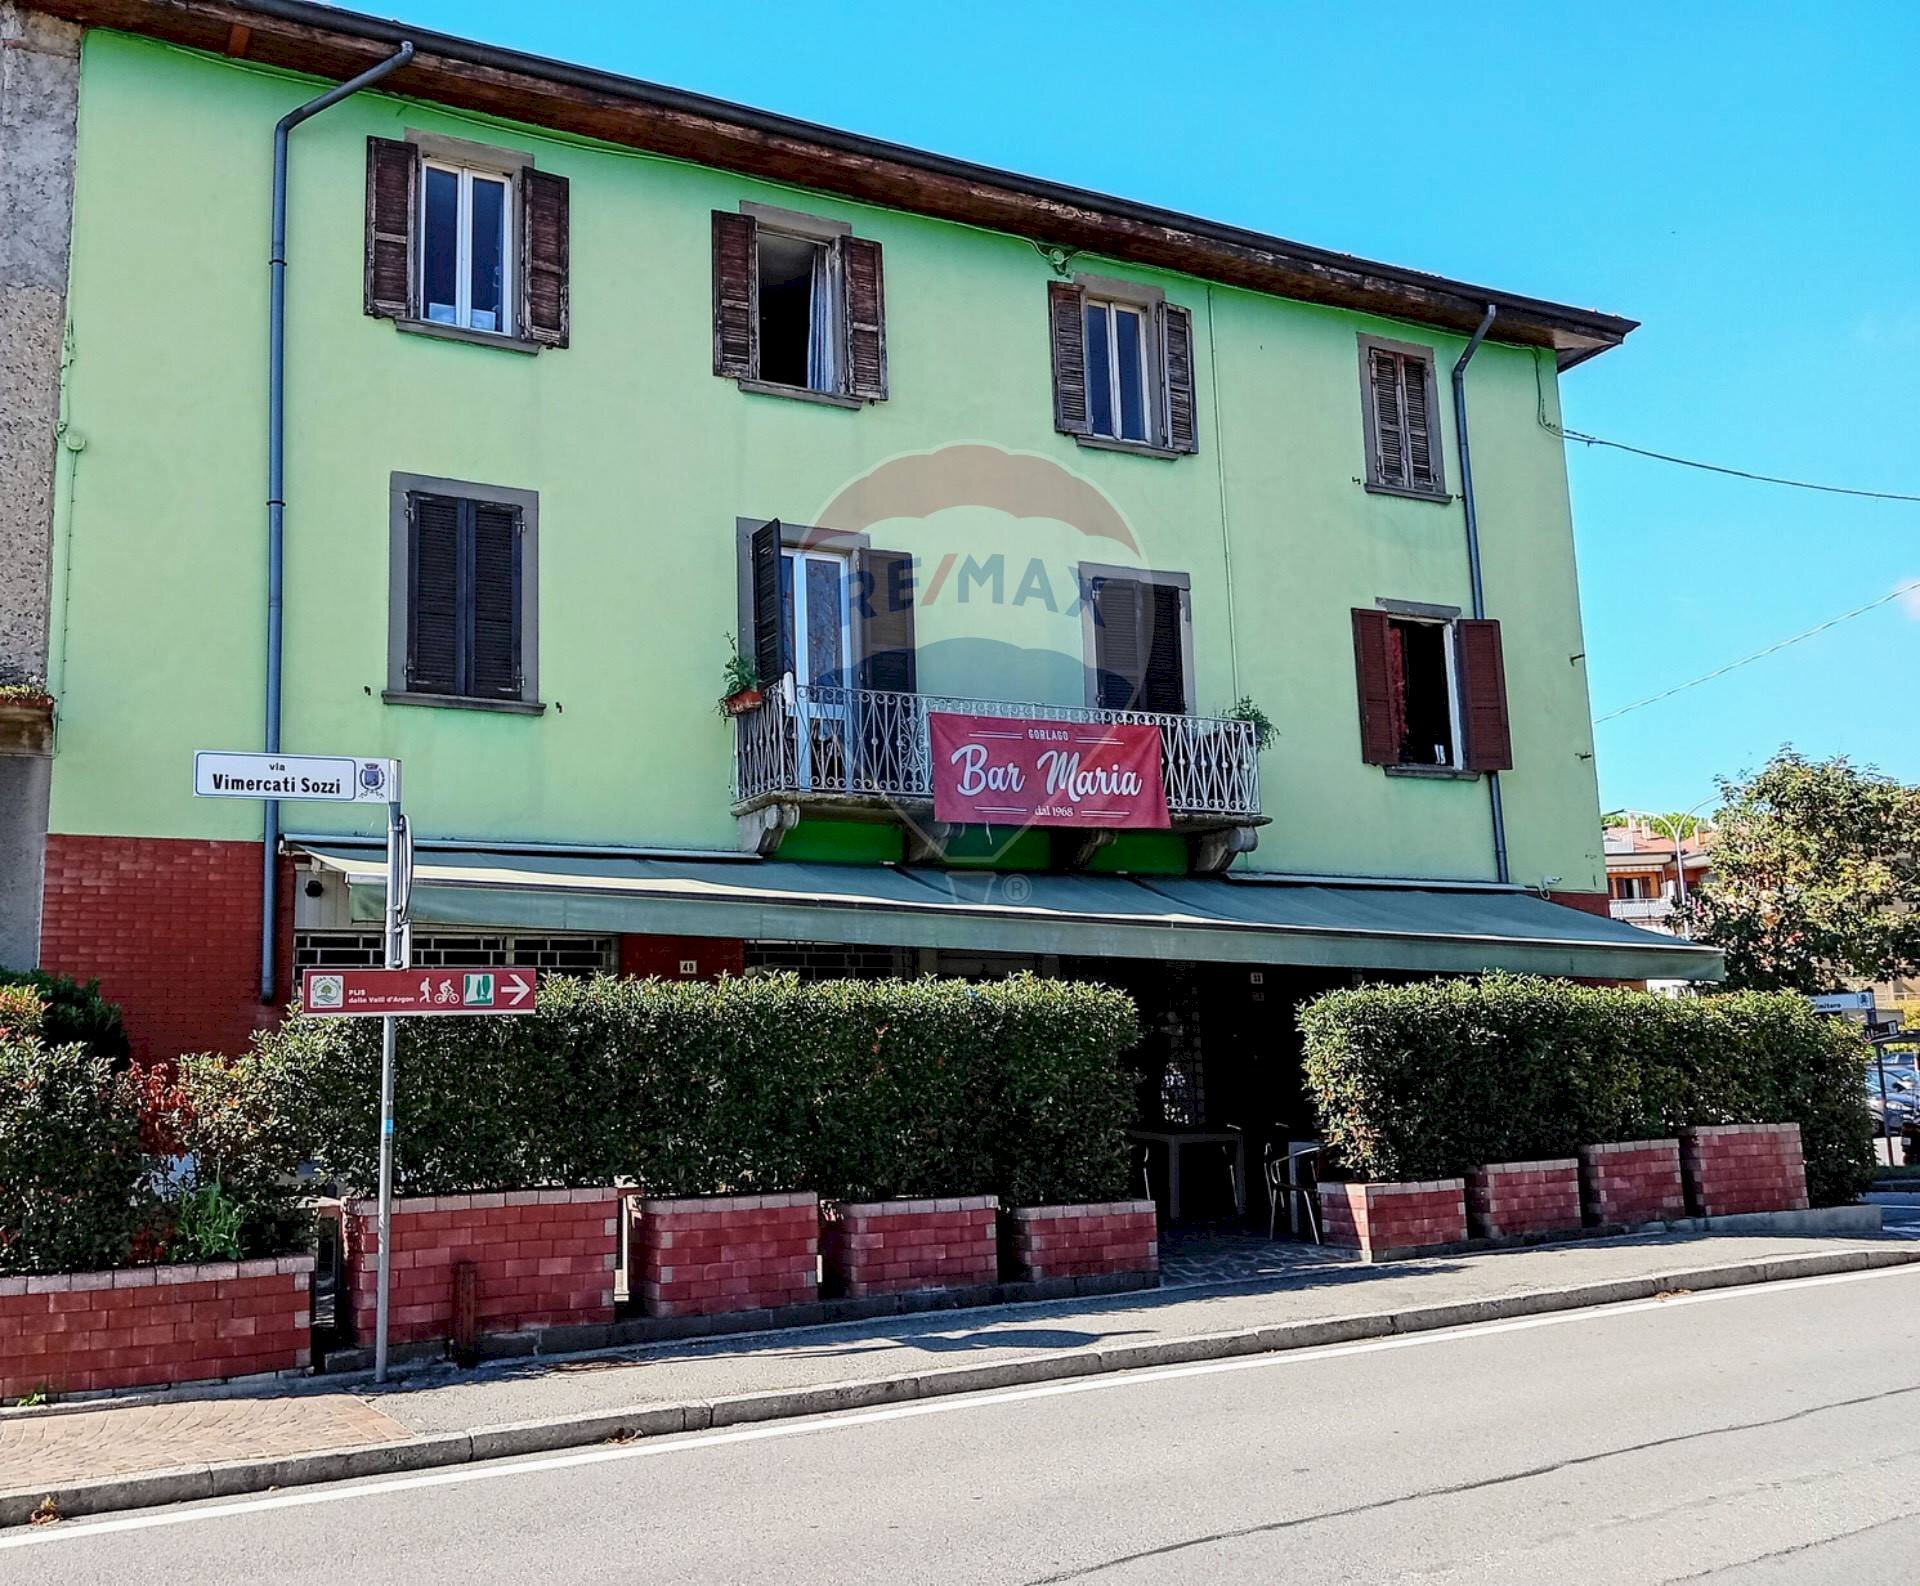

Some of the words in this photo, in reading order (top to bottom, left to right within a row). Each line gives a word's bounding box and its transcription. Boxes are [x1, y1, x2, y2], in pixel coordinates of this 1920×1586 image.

[1028, 728, 1069, 741] GORLAGO
[268, 762, 285, 771] via
[951, 743, 1026, 796] Bar
[1036, 750, 1142, 802] Maria
[212, 773, 296, 792] Vimercati
[301, 777, 340, 794] Sozzi
[1034, 806, 1051, 816] dal
[1052, 806, 1074, 817] 1968
[682, 962, 694, 972] 49
